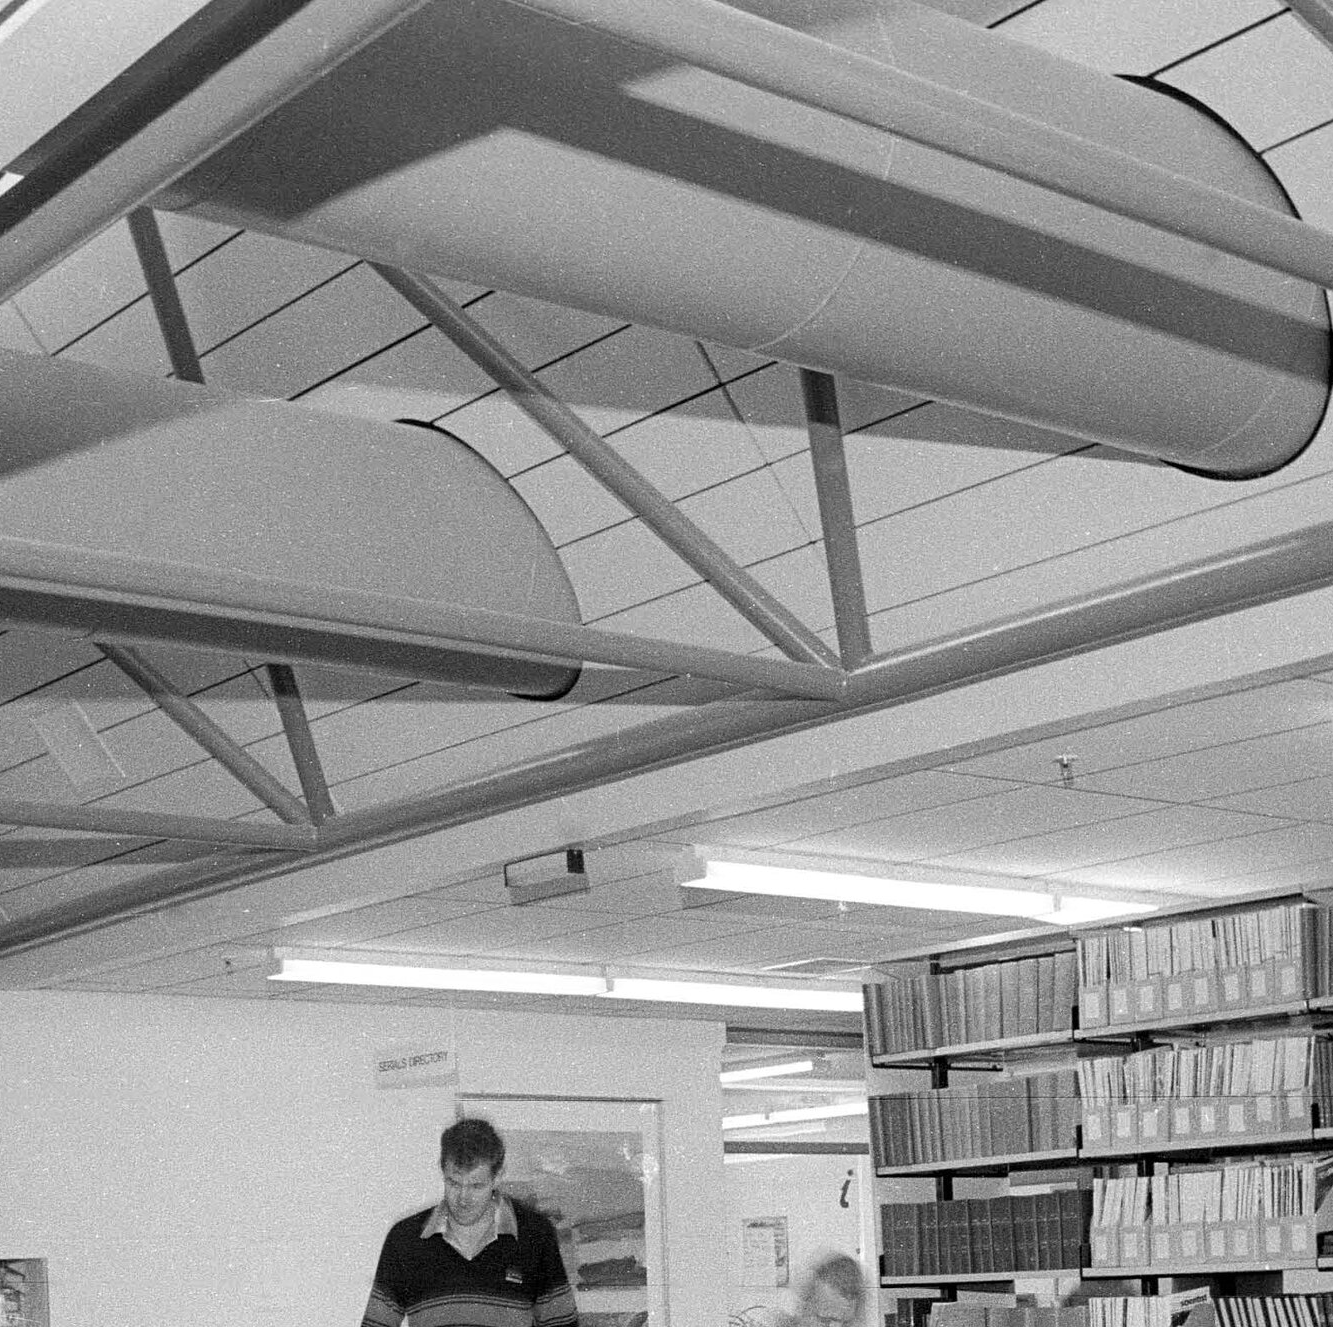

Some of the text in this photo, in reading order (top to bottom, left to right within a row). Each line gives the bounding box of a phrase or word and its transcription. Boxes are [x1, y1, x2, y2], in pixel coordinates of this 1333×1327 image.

[378, 1051, 448, 1072] SERIALS DIRECTORY
[840, 1169, 854, 1208] i
